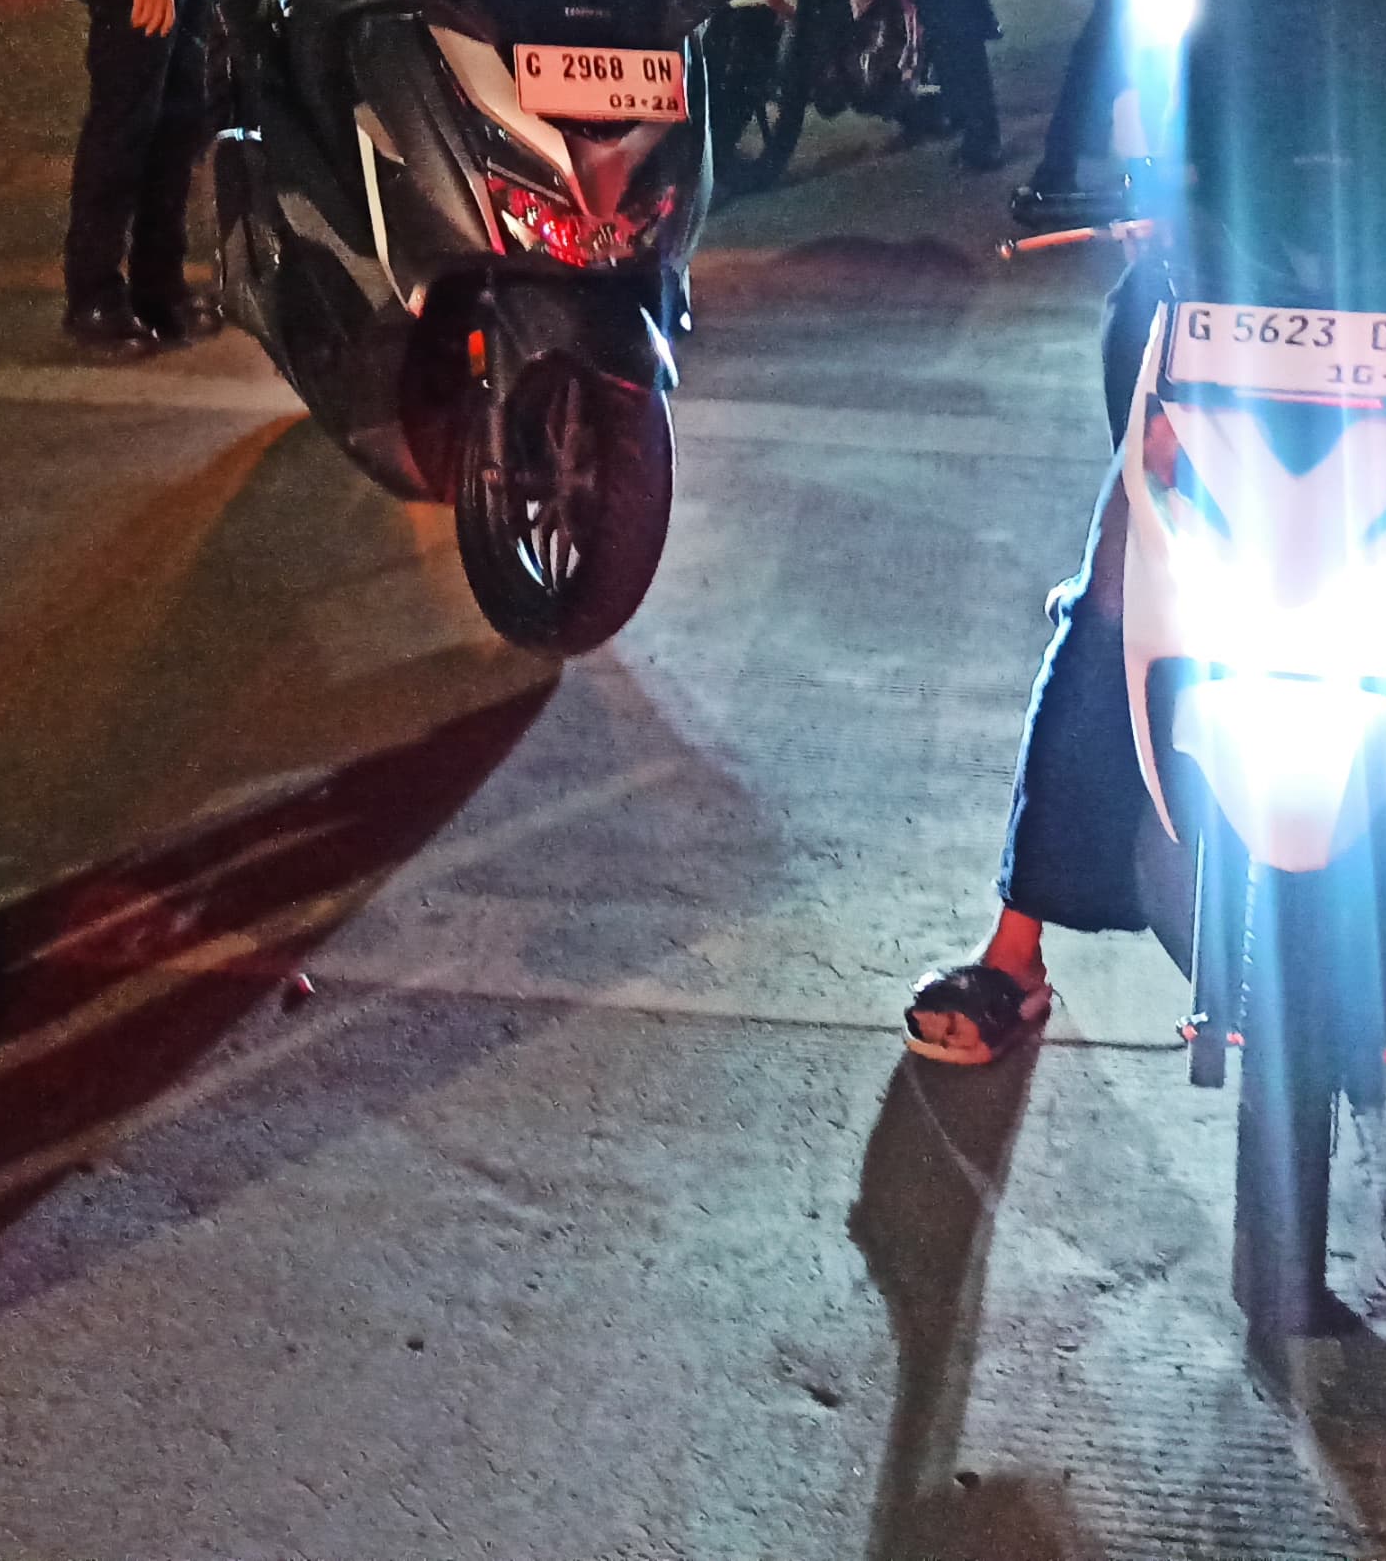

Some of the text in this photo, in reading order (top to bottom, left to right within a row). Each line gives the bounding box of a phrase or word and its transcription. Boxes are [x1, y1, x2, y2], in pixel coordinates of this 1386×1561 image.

[525, 51, 541, 79] G
[562, 52, 625, 82] 2968
[1188, 308, 1212, 342] G
[1232, 310, 1337, 349] 5623
